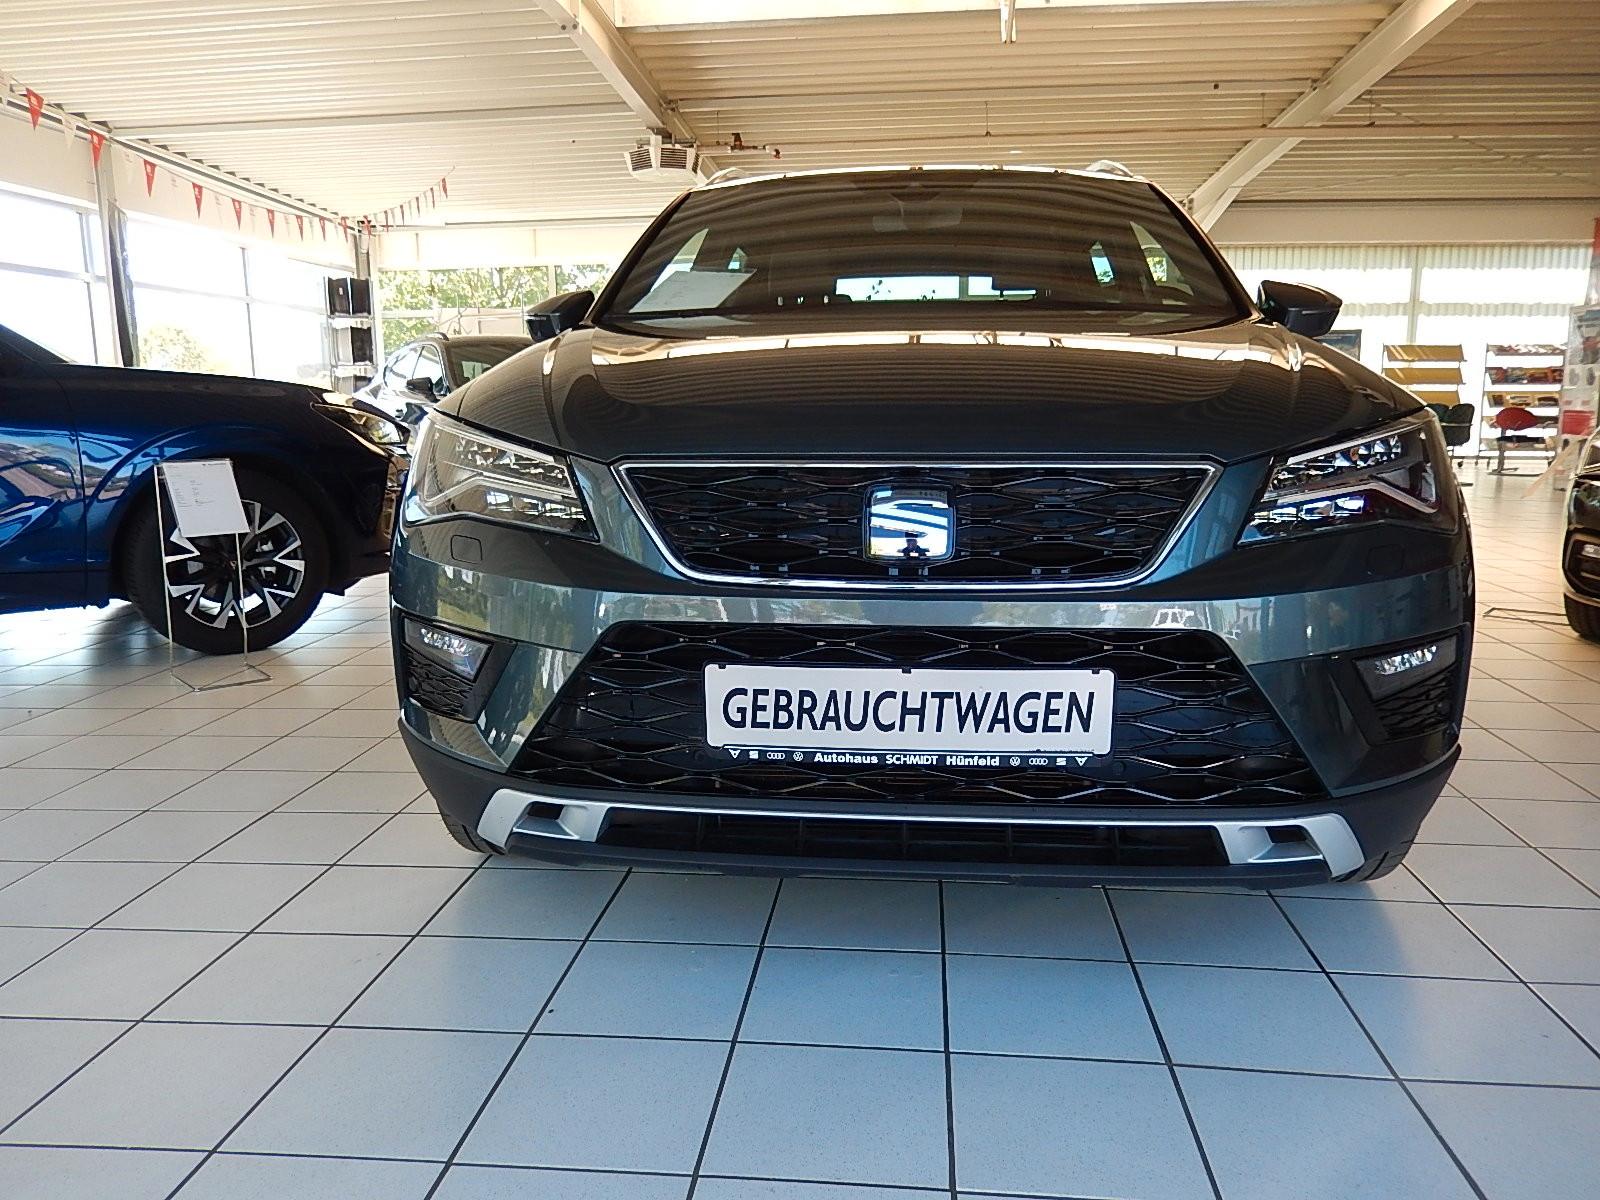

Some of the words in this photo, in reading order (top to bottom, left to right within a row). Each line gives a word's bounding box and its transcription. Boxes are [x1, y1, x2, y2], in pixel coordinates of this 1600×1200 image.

[722, 688, 1095, 733] GEBRAUCHTWAGEN
[813, 752, 878, 764] Autohaus
[886, 754, 938, 765] SCHMIDT
[946, 755, 1000, 766] Hünfeld
